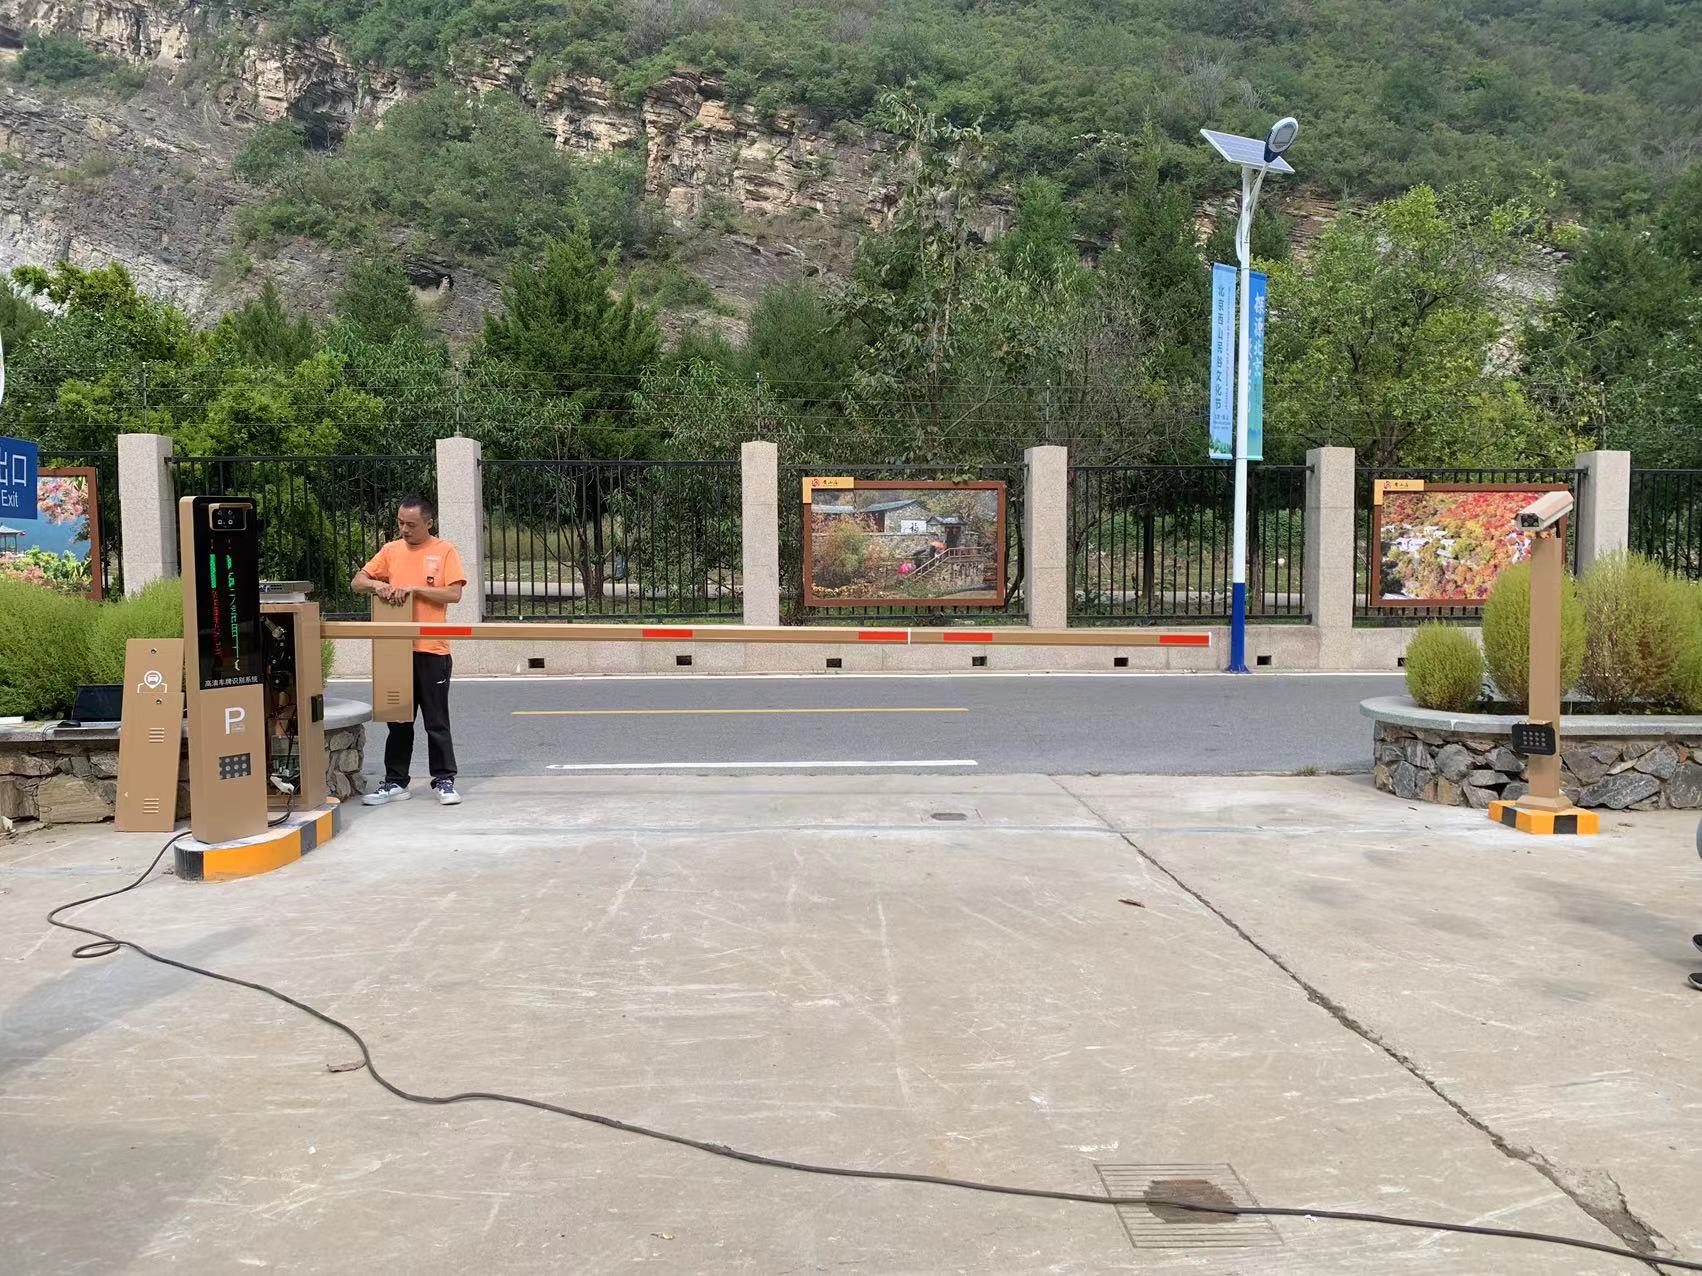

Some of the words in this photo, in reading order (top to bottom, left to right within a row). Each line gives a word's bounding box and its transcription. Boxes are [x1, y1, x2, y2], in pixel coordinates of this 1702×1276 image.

[1, 489, 19, 508] Exit
[204, 675, 258, 688] 高清车牌识别系统
[225, 706, 245, 734] P
